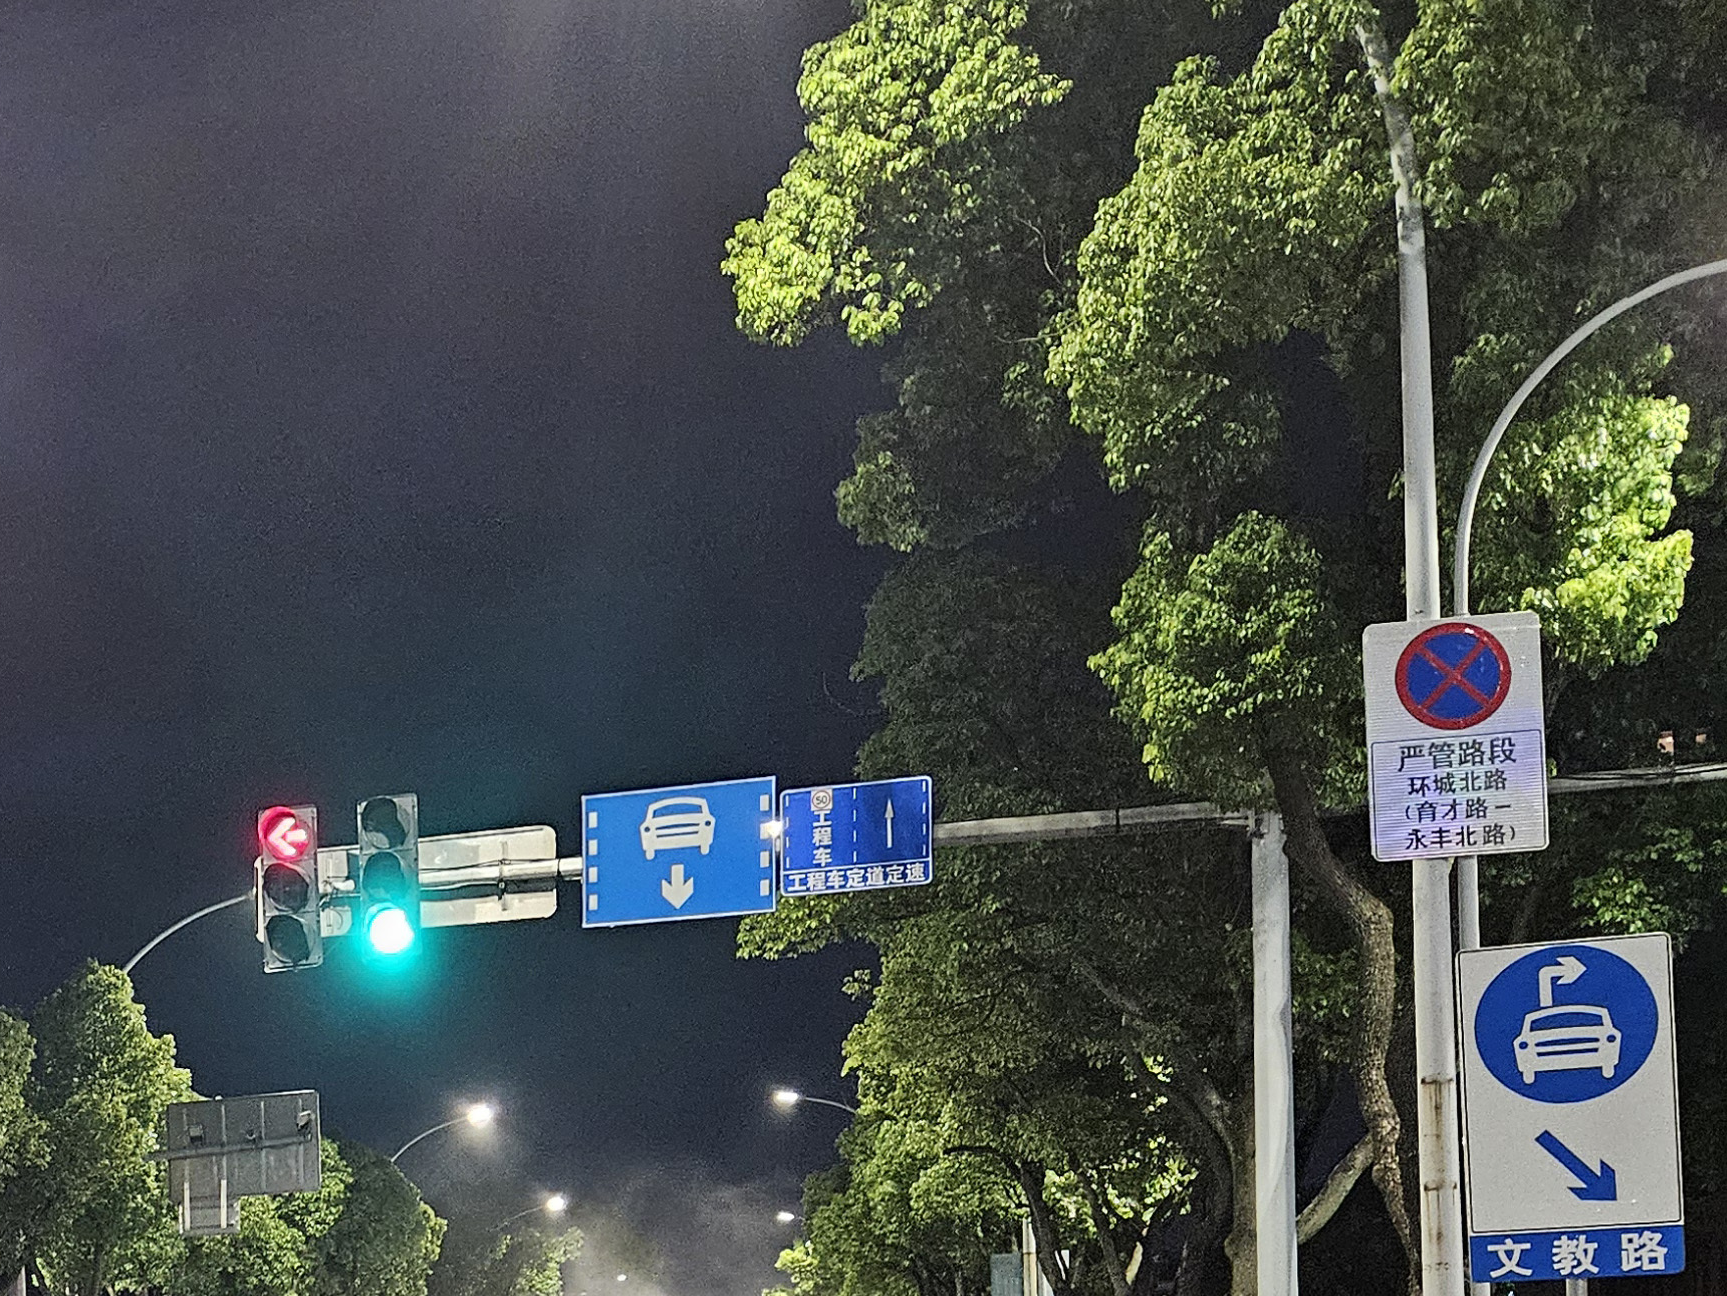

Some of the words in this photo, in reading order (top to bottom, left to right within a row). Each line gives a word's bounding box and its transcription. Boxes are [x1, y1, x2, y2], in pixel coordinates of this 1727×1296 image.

[1398, 737, 1517, 772] 严管路段
[1407, 768, 1508, 798] 环城北路
[812, 809, 833, 867] 工程车
[786, 862, 926, 892] 工程车定道定速
[1486, 1230, 1669, 1280] 文教路
